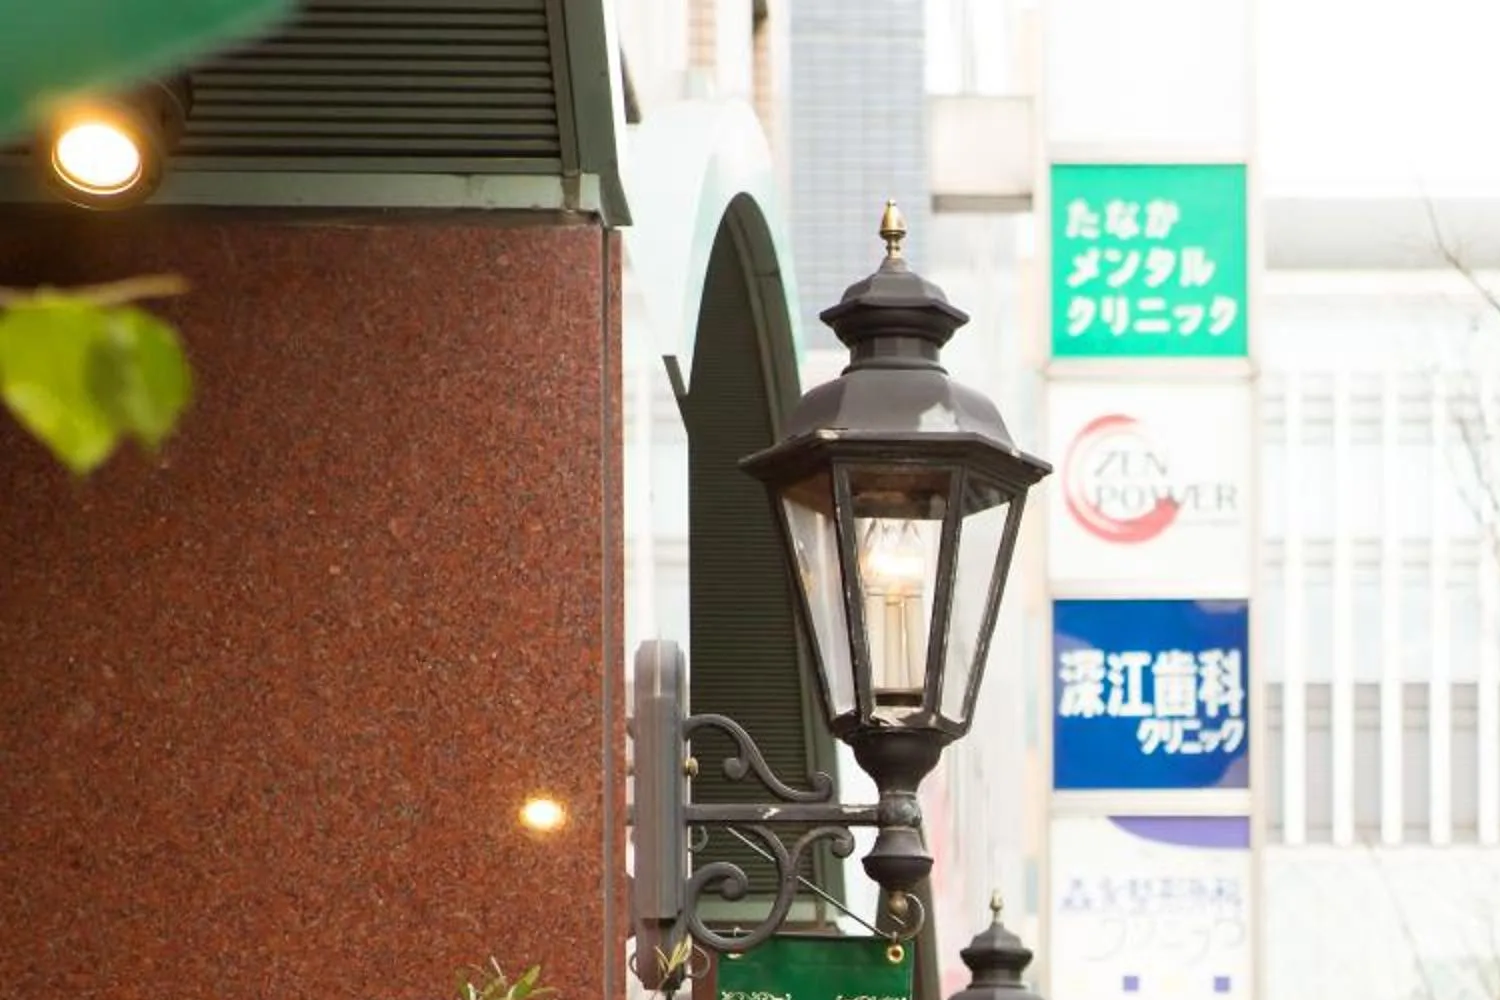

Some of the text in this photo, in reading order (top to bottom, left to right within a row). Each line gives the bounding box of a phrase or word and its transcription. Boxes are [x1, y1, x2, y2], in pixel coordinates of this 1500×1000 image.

[1065, 199, 1179, 238] たなか
[1066, 247, 1216, 288] メンタル
[1067, 295, 1238, 336] クリニック
[1058, 648, 1245, 719] 深江歯科
[1136, 718, 1245, 755] クリニック
